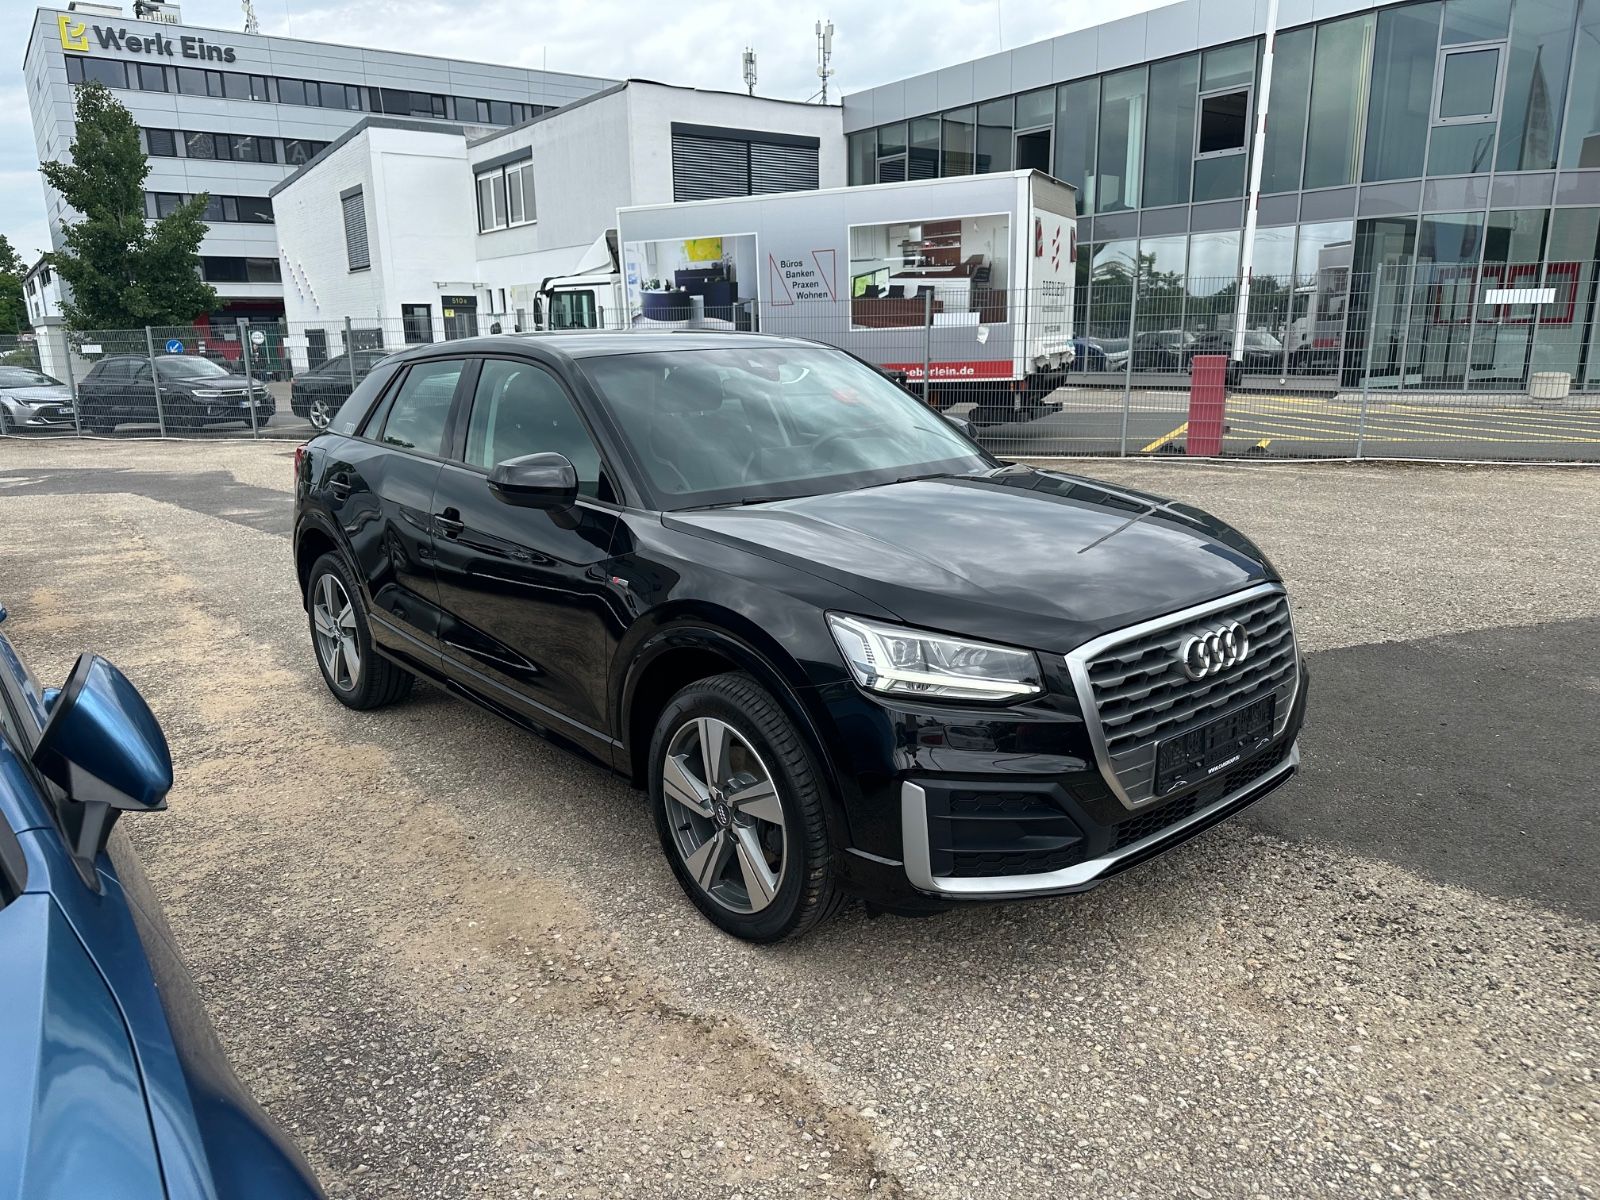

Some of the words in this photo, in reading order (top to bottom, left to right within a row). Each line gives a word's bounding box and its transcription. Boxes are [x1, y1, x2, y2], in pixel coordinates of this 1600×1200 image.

[93, 25, 174, 56] Werk
[180, 36, 236, 63] Eins
[780, 260, 803, 268] Büros
[785, 270, 815, 279] Banken
[792, 281, 819, 289] Praxen
[796, 291, 828, 300] Wohnen
